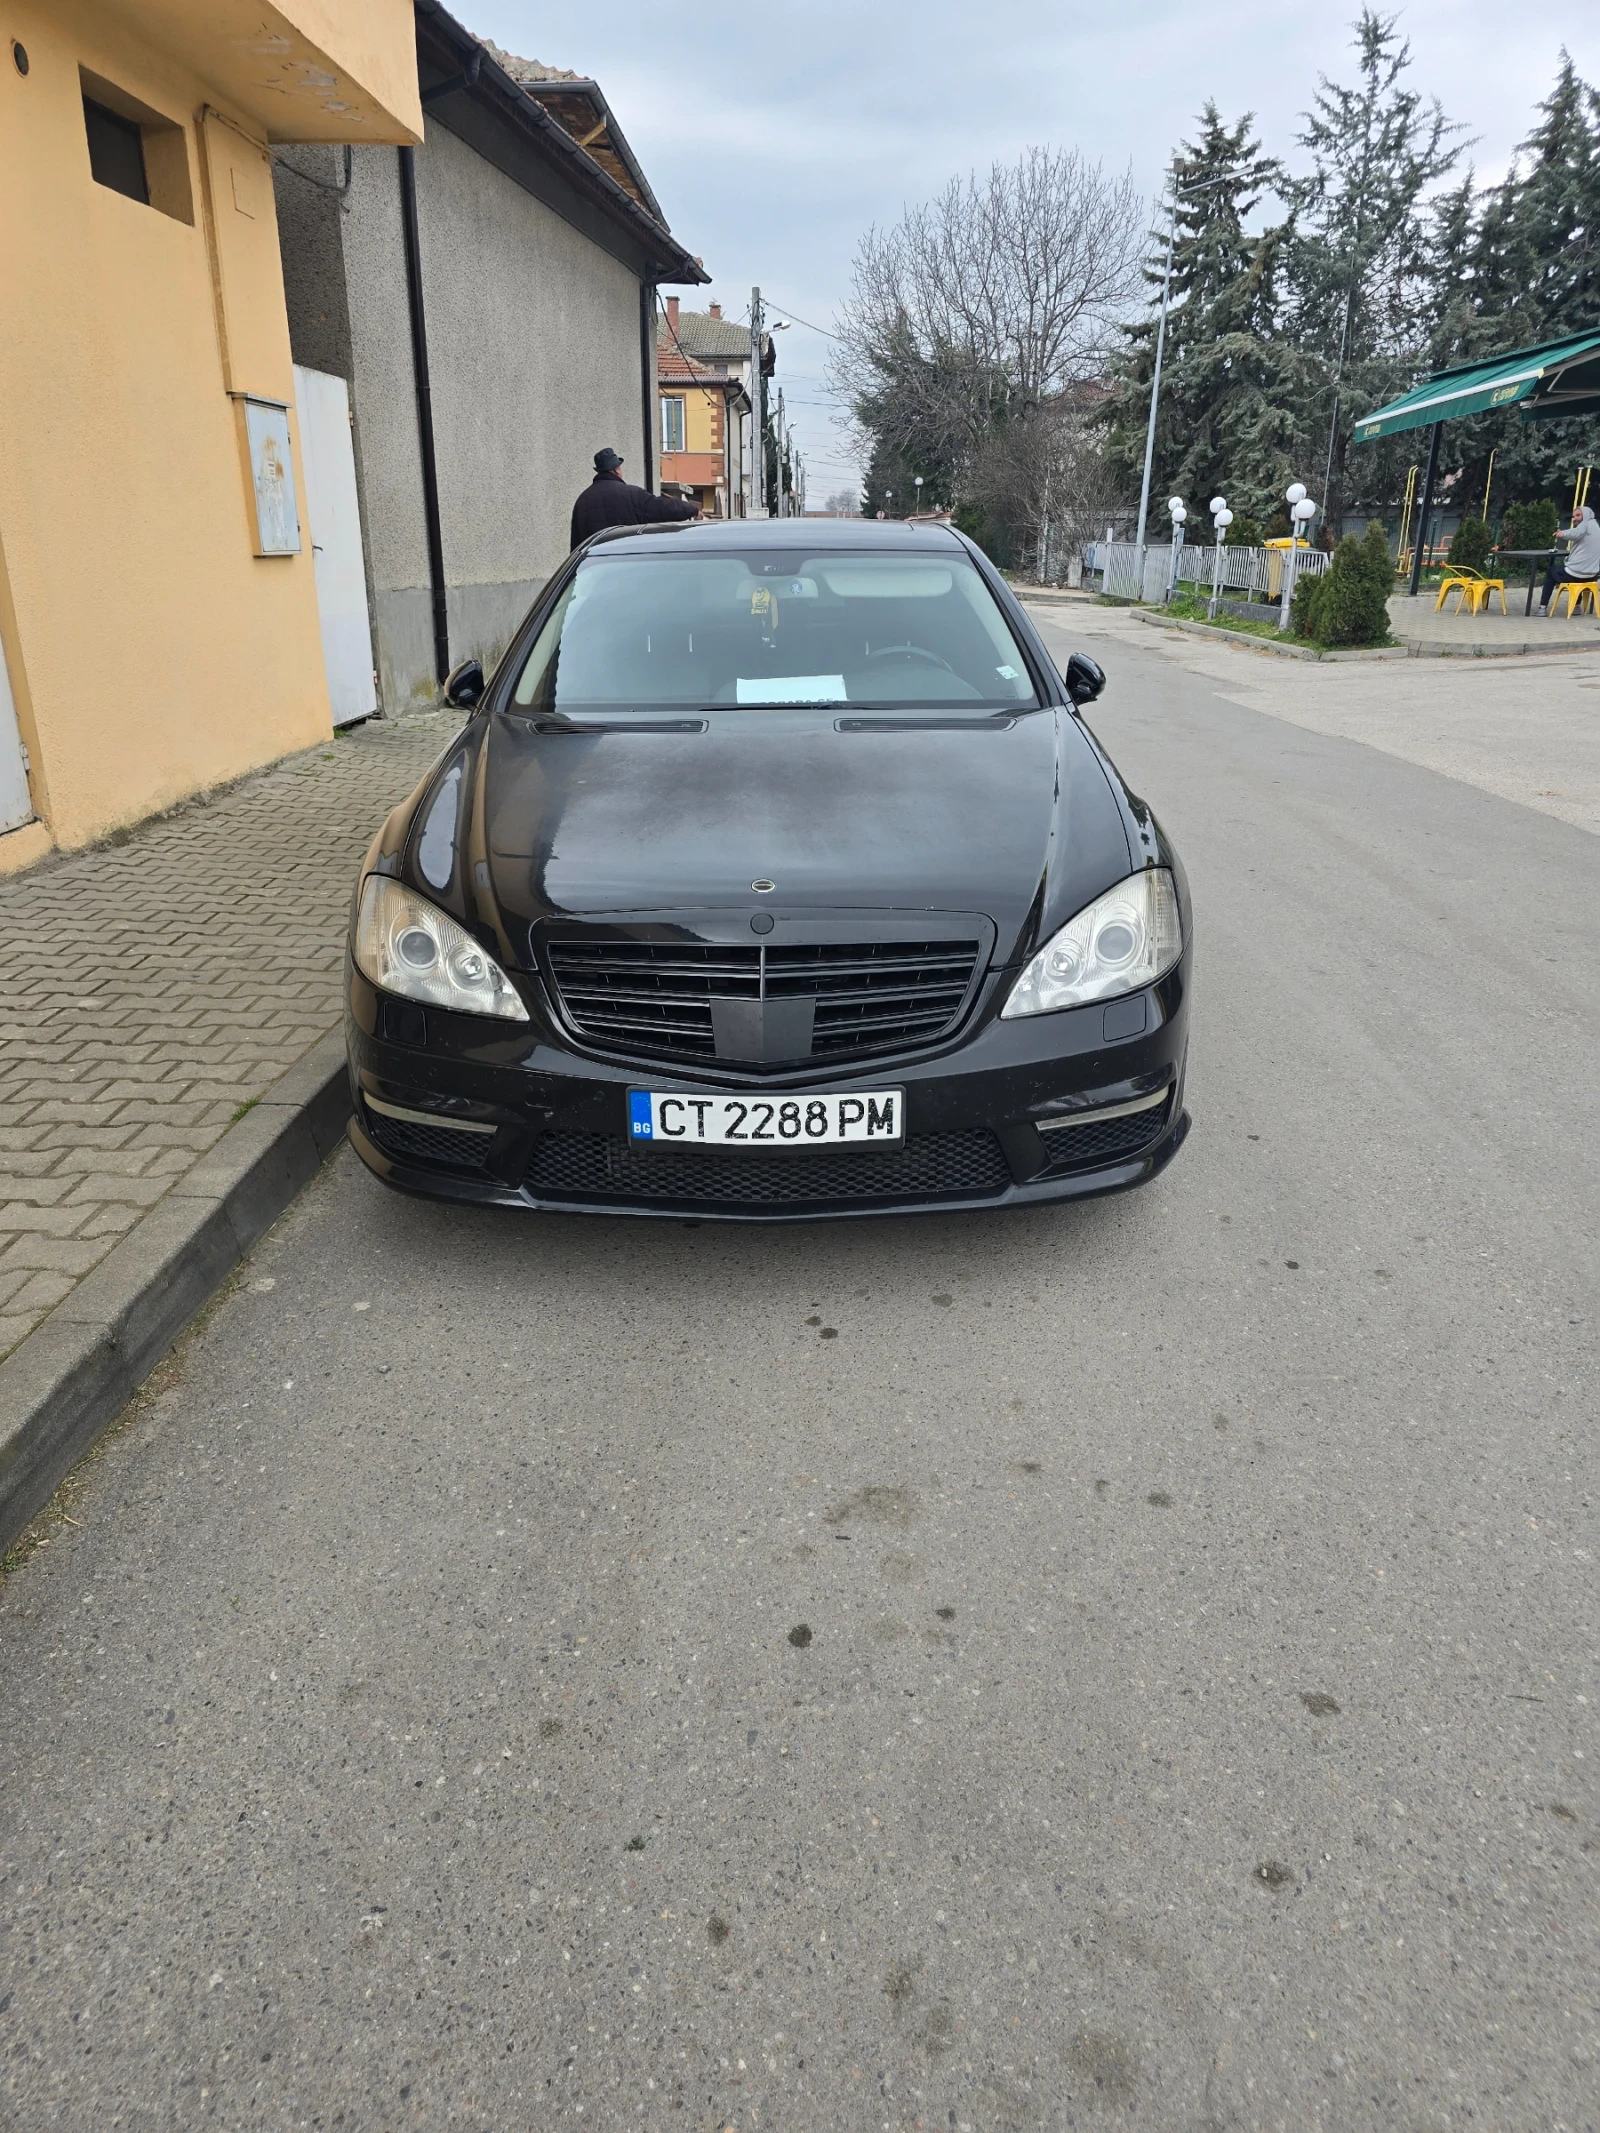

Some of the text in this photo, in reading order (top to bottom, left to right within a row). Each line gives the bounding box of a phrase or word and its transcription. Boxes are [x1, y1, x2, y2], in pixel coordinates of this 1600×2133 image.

[633, 1097, 894, 1139] BG CT 2288 PM
